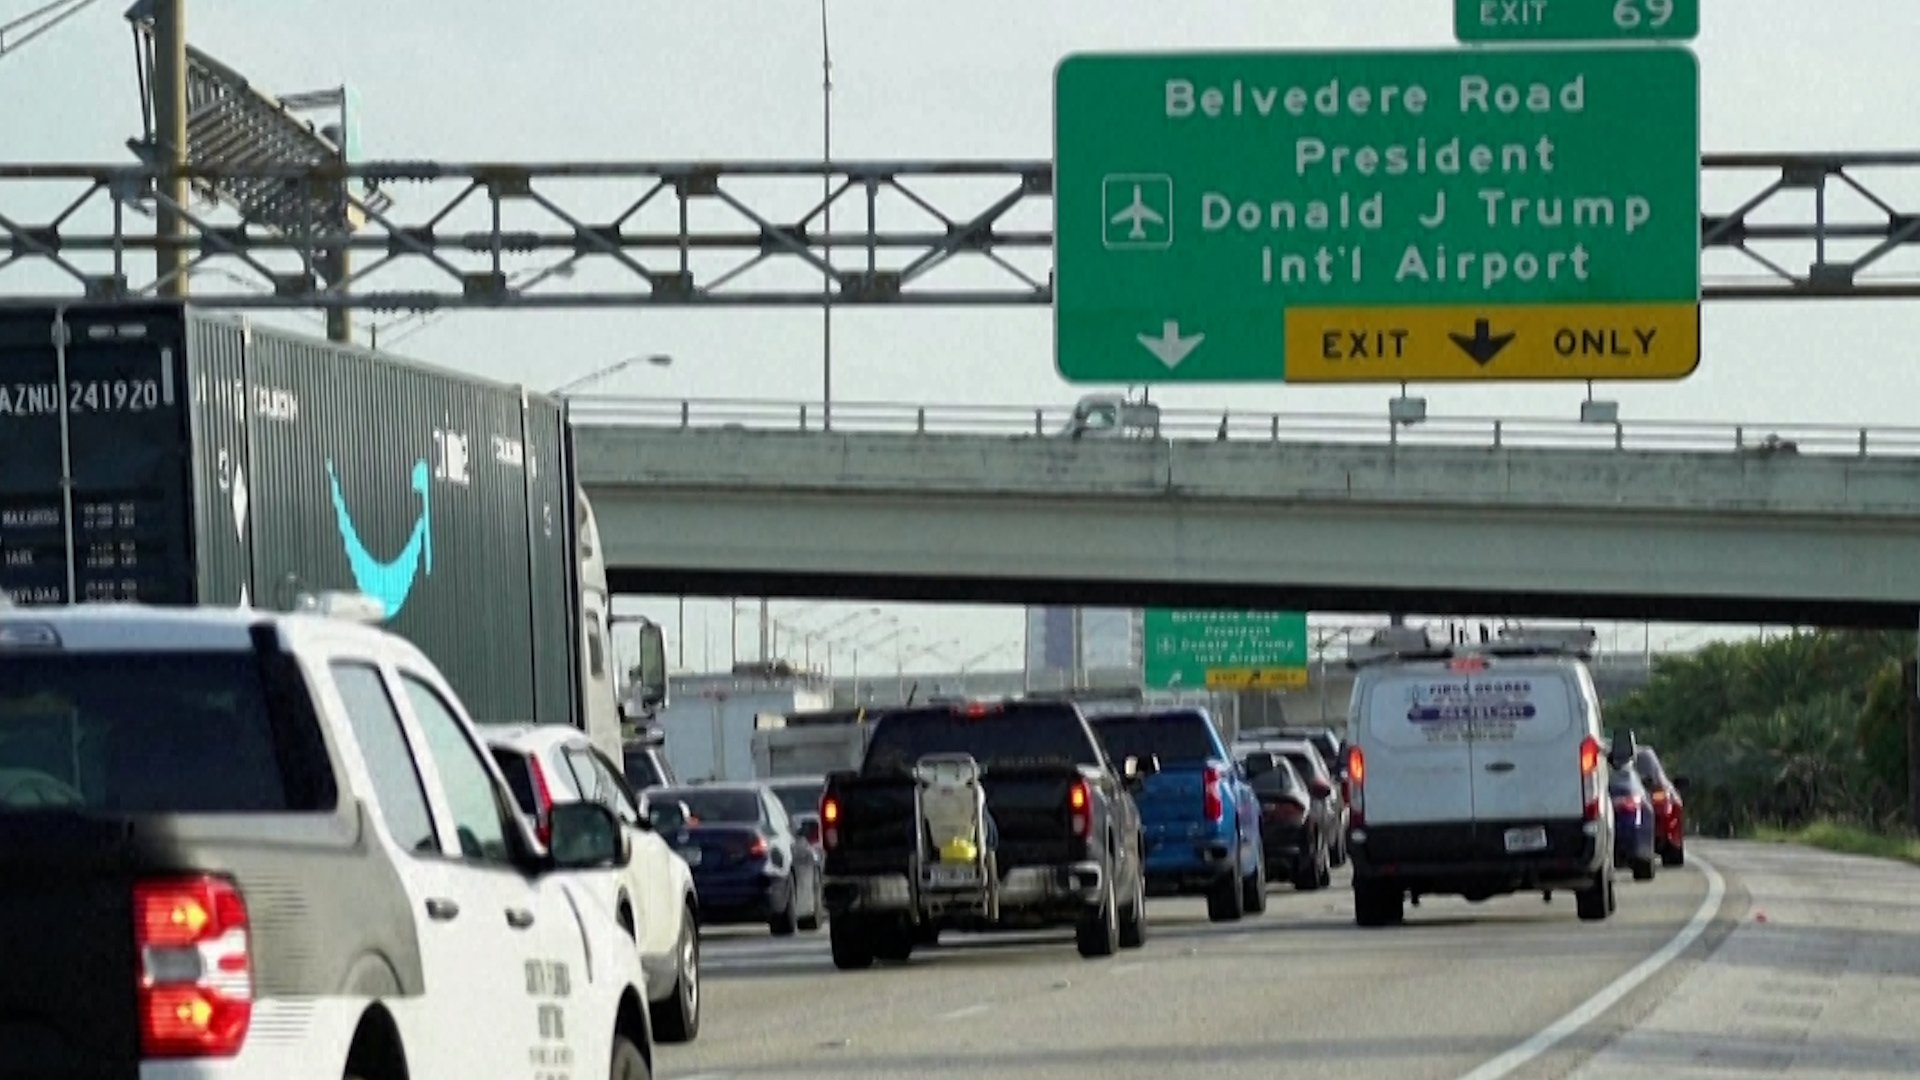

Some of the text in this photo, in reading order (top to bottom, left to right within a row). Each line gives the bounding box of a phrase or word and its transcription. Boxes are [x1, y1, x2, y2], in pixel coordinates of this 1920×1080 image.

[1479, 0, 1674, 28] EXIT 69
[1165, 75, 1586, 117] Belvedere Road
[1296, 137, 1555, 175] President
[1200, 190, 1652, 234] Donald J Trump
[1261, 246, 1591, 289] Int'l Airport
[1321, 327, 1658, 359] EXIT ONLY
[0, 382, 58, 415] AZNU
[69, 379, 158, 412] 241920
